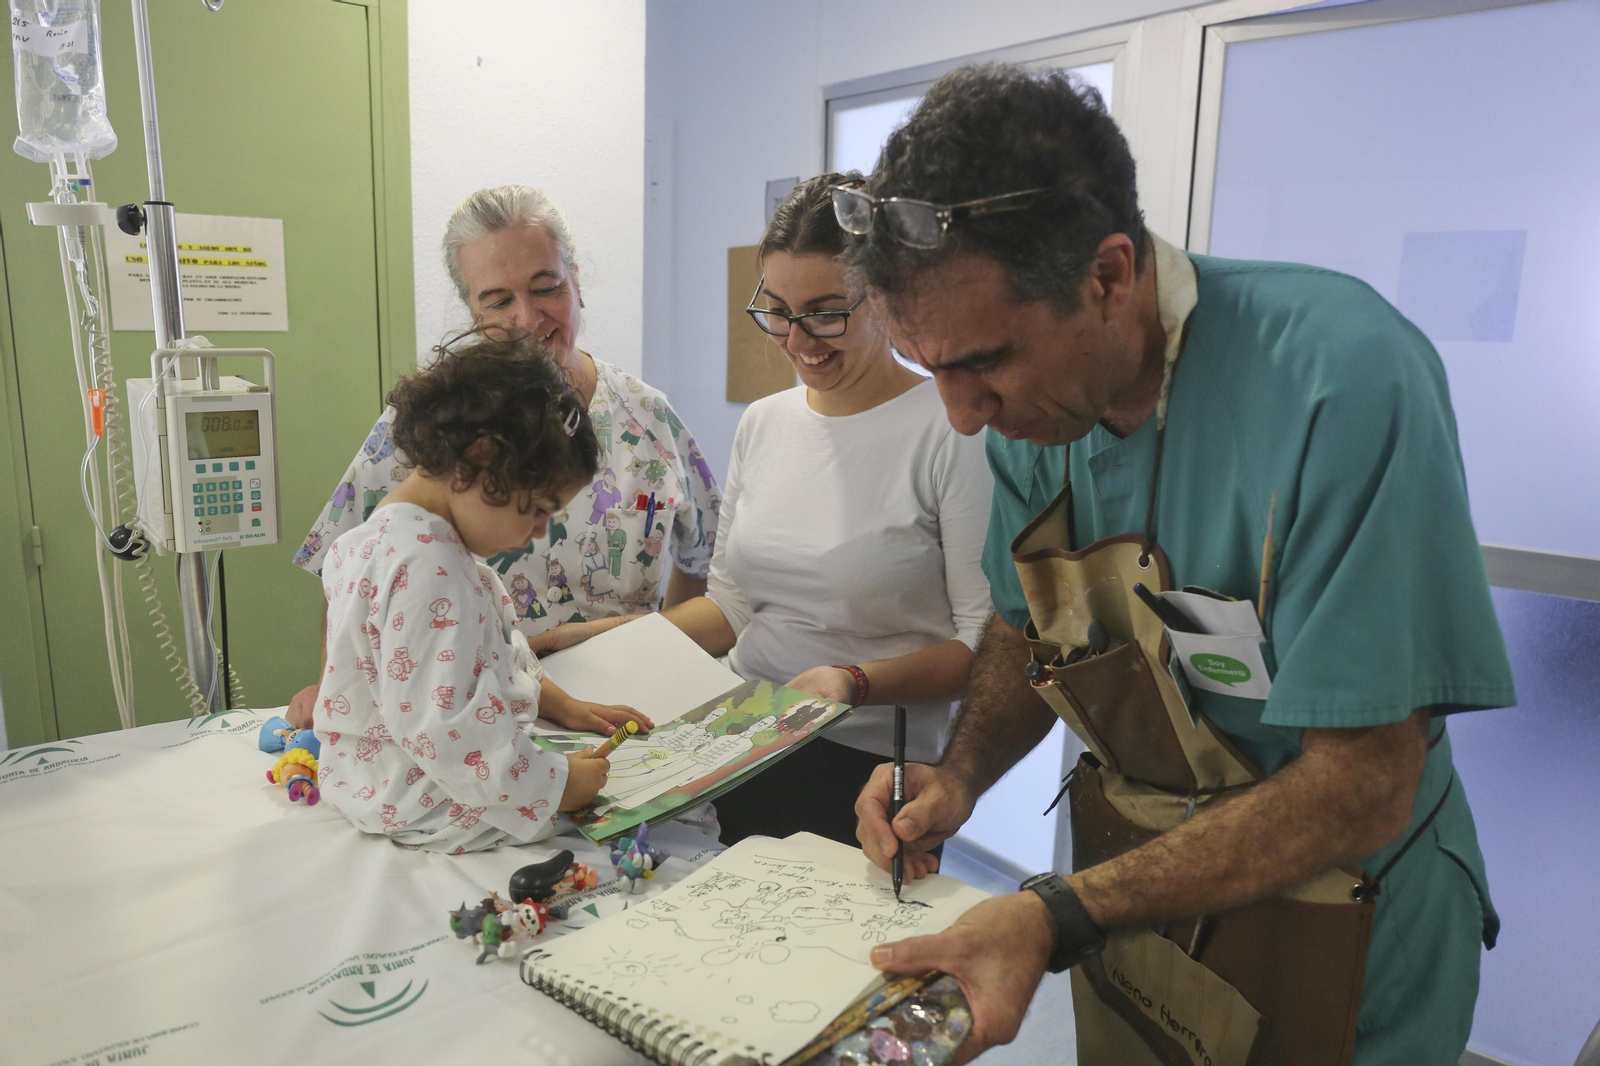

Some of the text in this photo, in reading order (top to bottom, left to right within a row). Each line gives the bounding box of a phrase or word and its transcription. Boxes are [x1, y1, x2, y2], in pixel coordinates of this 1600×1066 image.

[1197, 664, 1246, 676] Enfermer@
[1207, 659, 1225, 668] Soy
[367, 963, 380, 975] DE
[383, 955, 416, 972] JUNTA
[1112, 968, 1152, 1008] Neno
[107, 1044, 149, 1063] JUNTA
